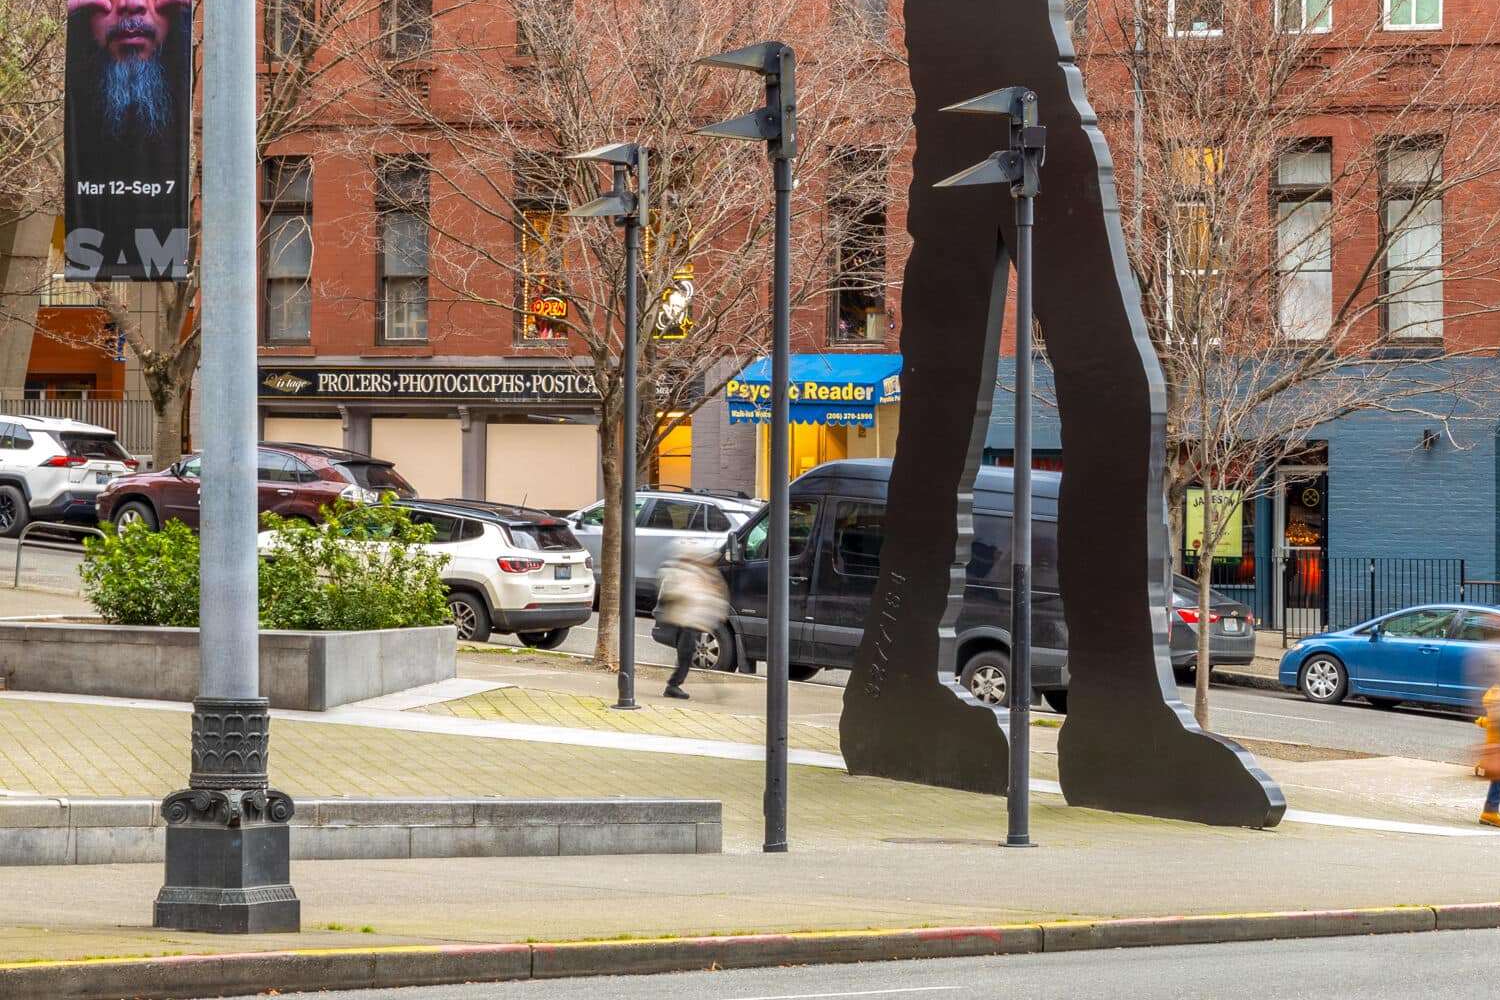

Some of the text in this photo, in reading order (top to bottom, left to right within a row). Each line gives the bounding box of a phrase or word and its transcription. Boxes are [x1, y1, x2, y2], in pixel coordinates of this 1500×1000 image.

[77, 181, 105, 195] Mar
[165, 180, 176, 195] 7
[64, 227, 189, 281] SAM
[533, 299, 567, 316] OPEN
[530, 373, 600, 394] POSTCA
[726, 380, 799, 401] Psycc
[804, 381, 875, 401] Reader
[1193, 495, 1236, 508] JAESON
